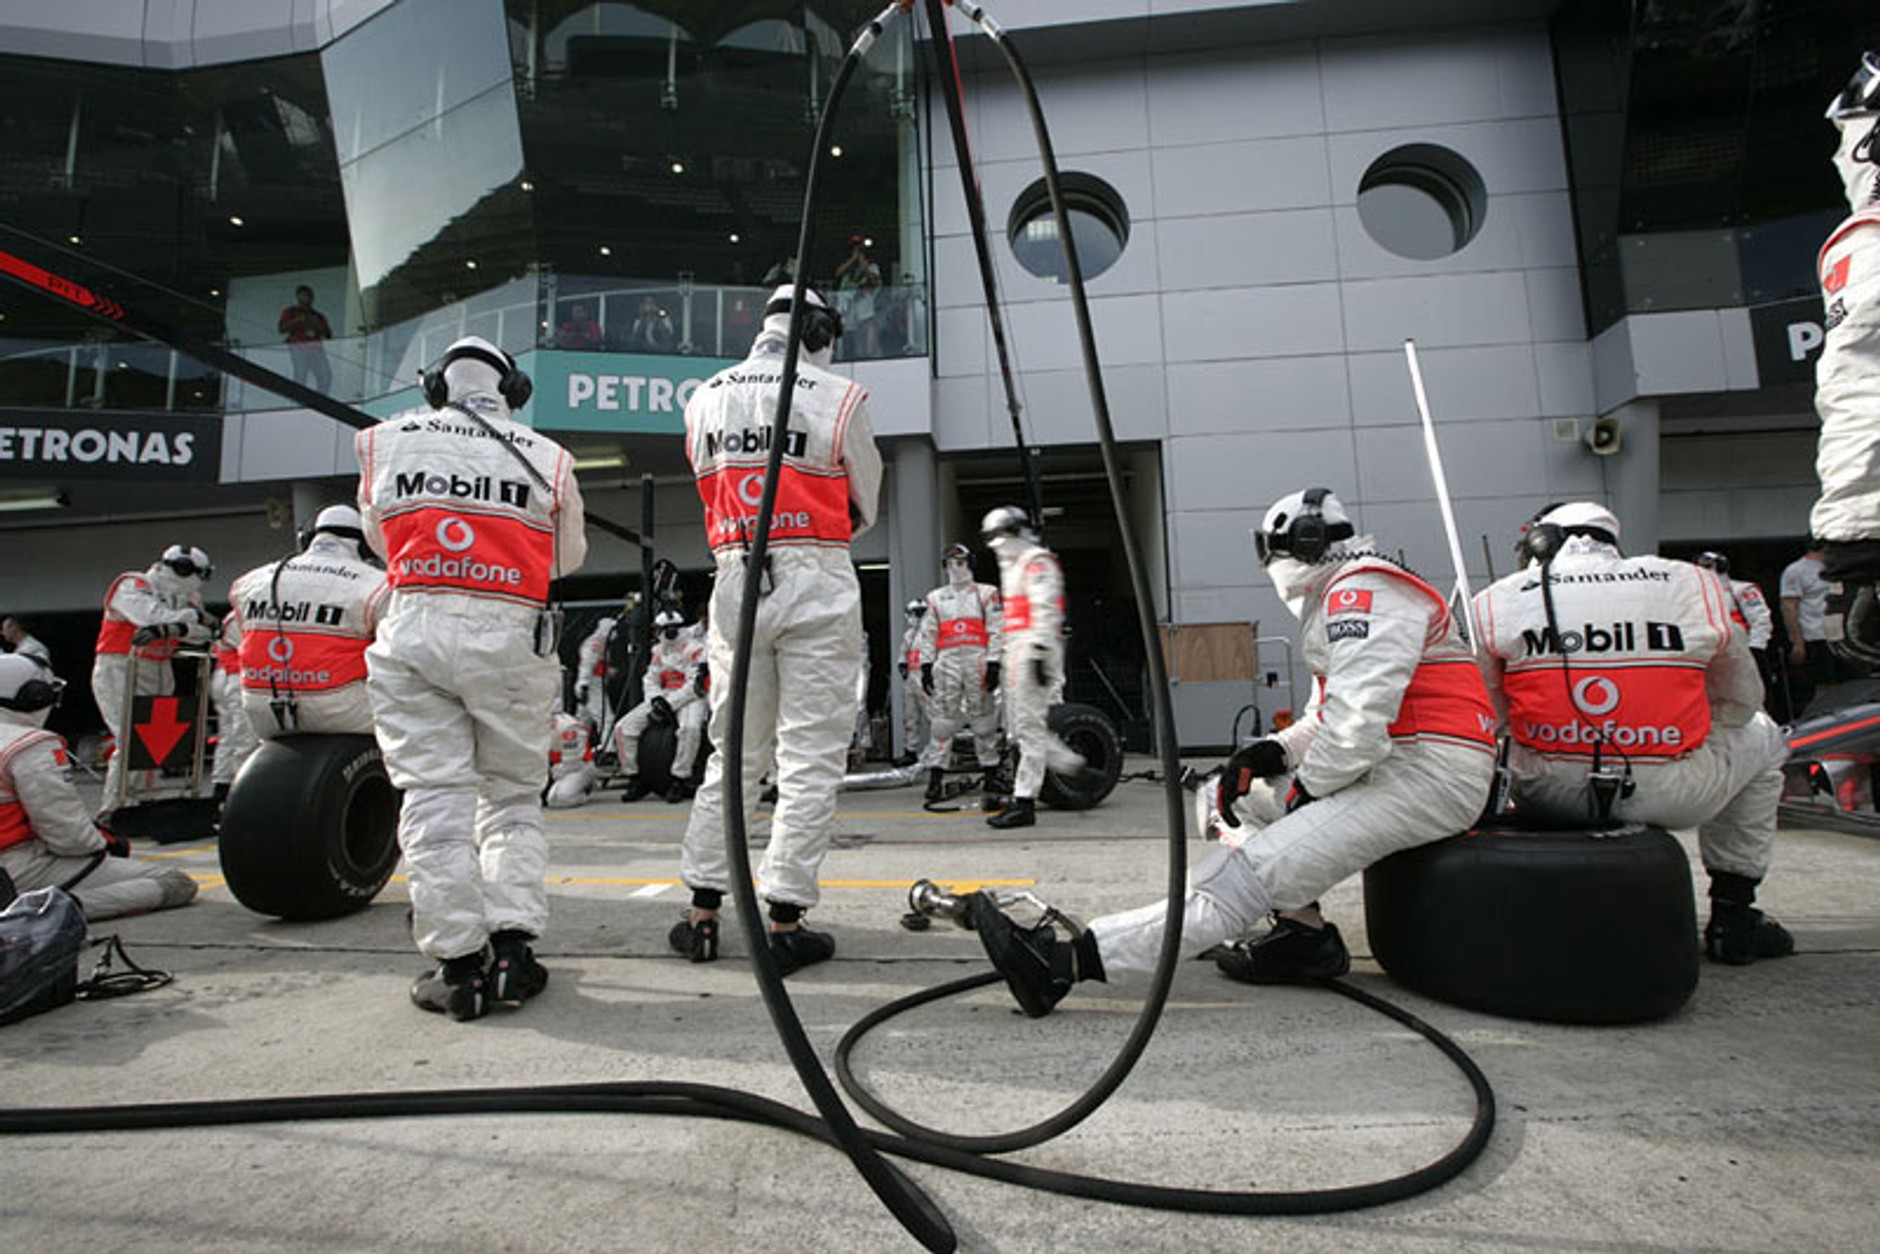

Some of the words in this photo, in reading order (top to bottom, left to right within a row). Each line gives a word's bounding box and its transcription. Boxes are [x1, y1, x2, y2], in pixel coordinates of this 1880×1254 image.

[726, 371, 818, 390] Santaer
[706, 424, 773, 459] Mobil
[396, 472, 491, 501] Mobil
[282, 562, 360, 580] Santander
[400, 553, 521, 585] vodafone
[1548, 566, 1671, 586] Santander
[245, 600, 311, 622] Mobil
[1522, 621, 1635, 656] Mobil
[1524, 718, 1682, 746] vodafone
